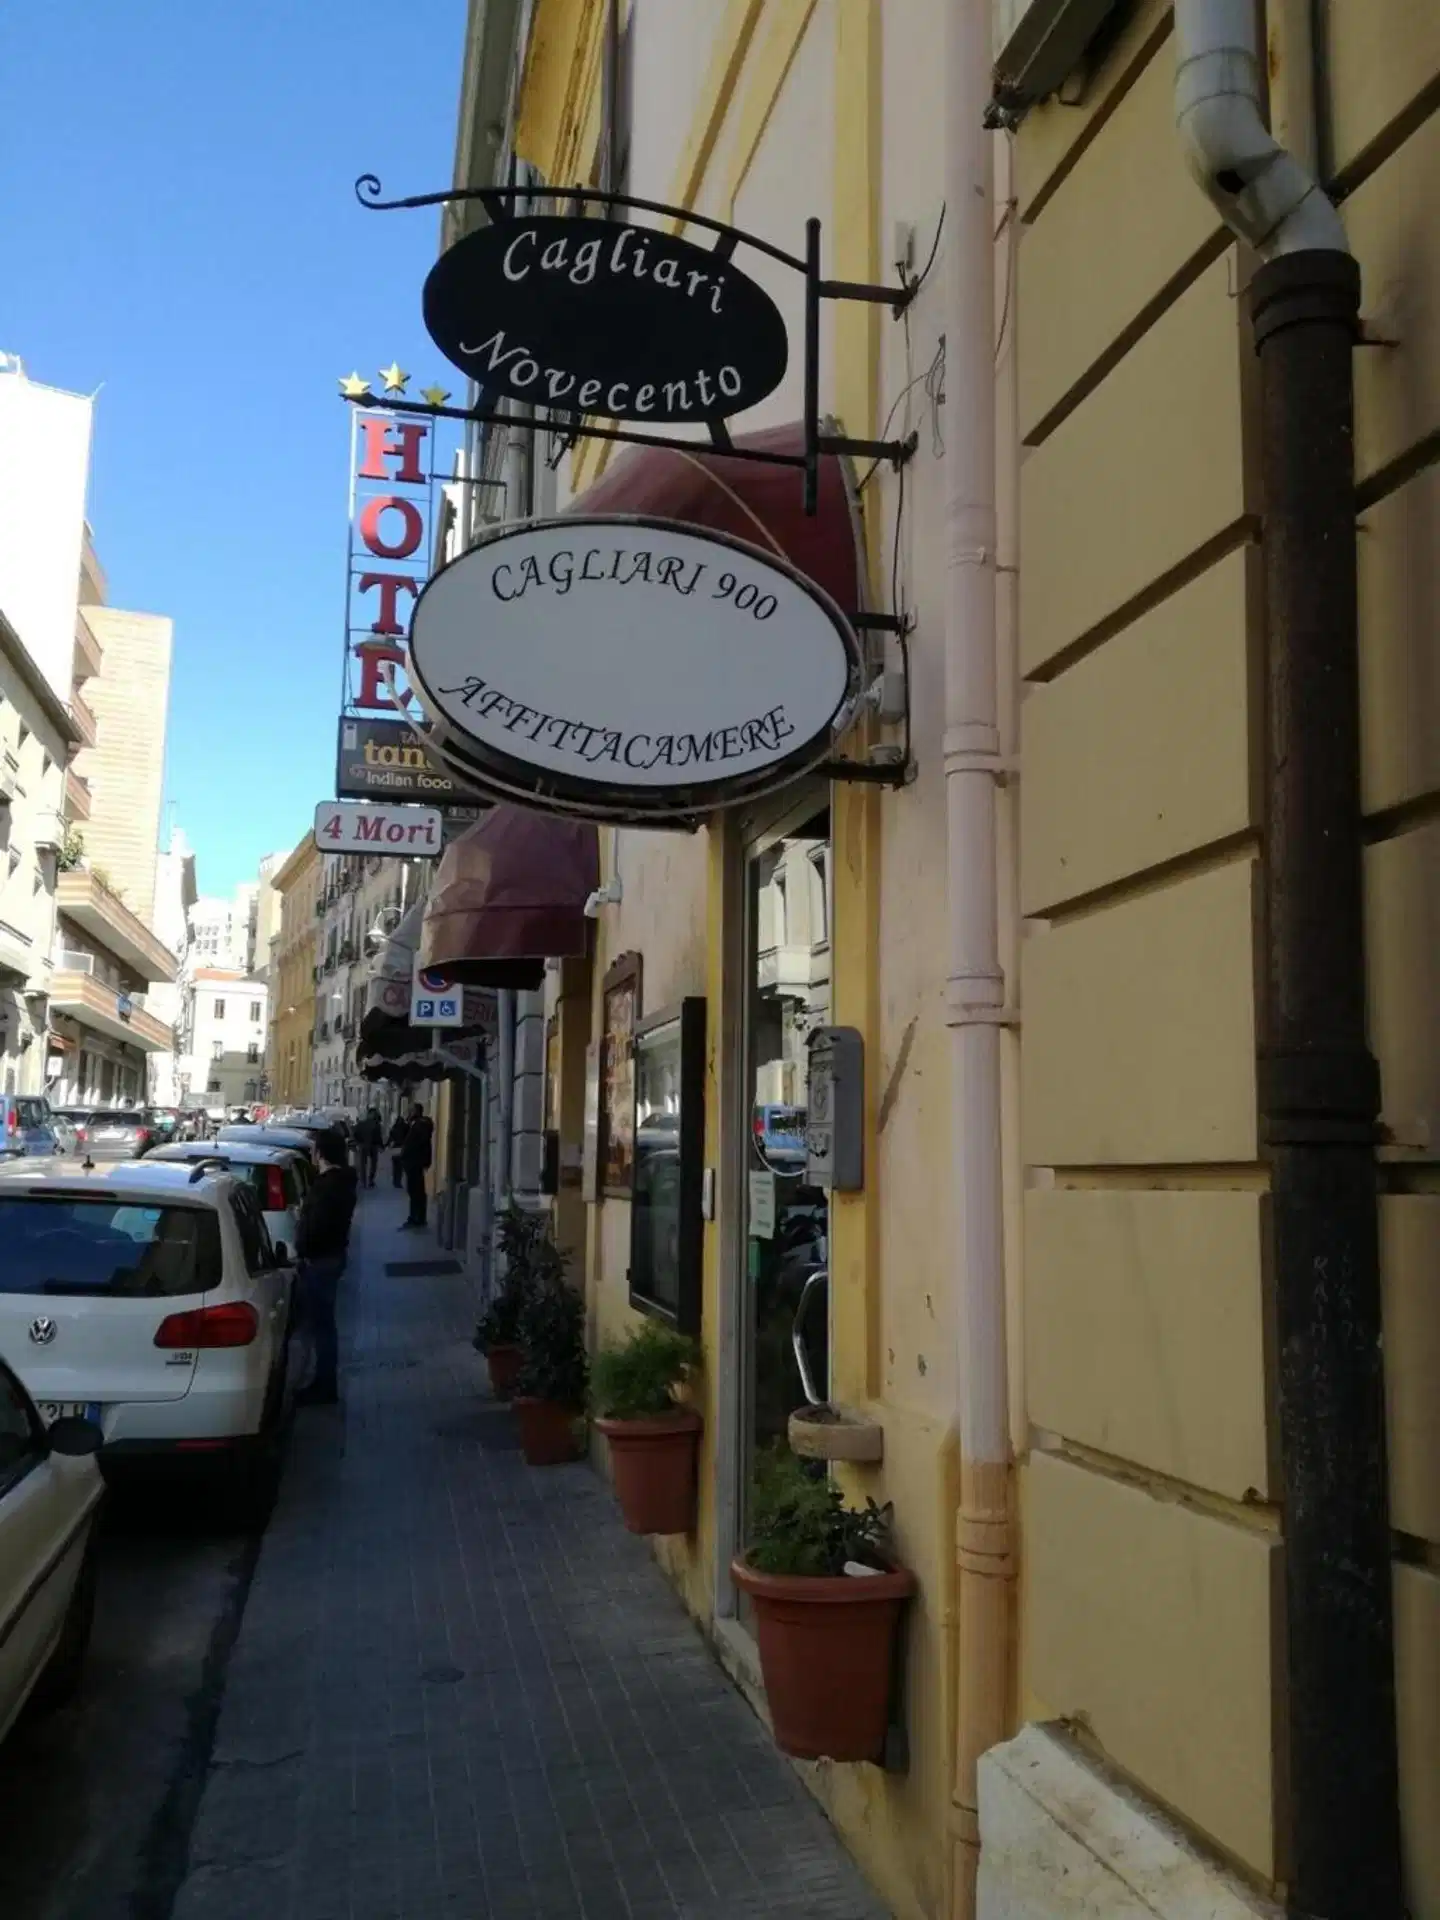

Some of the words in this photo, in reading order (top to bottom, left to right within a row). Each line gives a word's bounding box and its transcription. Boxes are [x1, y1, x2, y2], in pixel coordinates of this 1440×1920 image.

[503, 229, 725, 314] Cagliari
[459, 331, 742, 413] Novecento
[491, 549, 707, 602] CAGLIARI
[711, 573, 778, 620] 900
[438, 675, 795, 770] AFFITTACAMERE
[366, 770, 413, 788] Indian
[322, 815, 342, 839] 4
[352, 815, 436, 844] Mori
